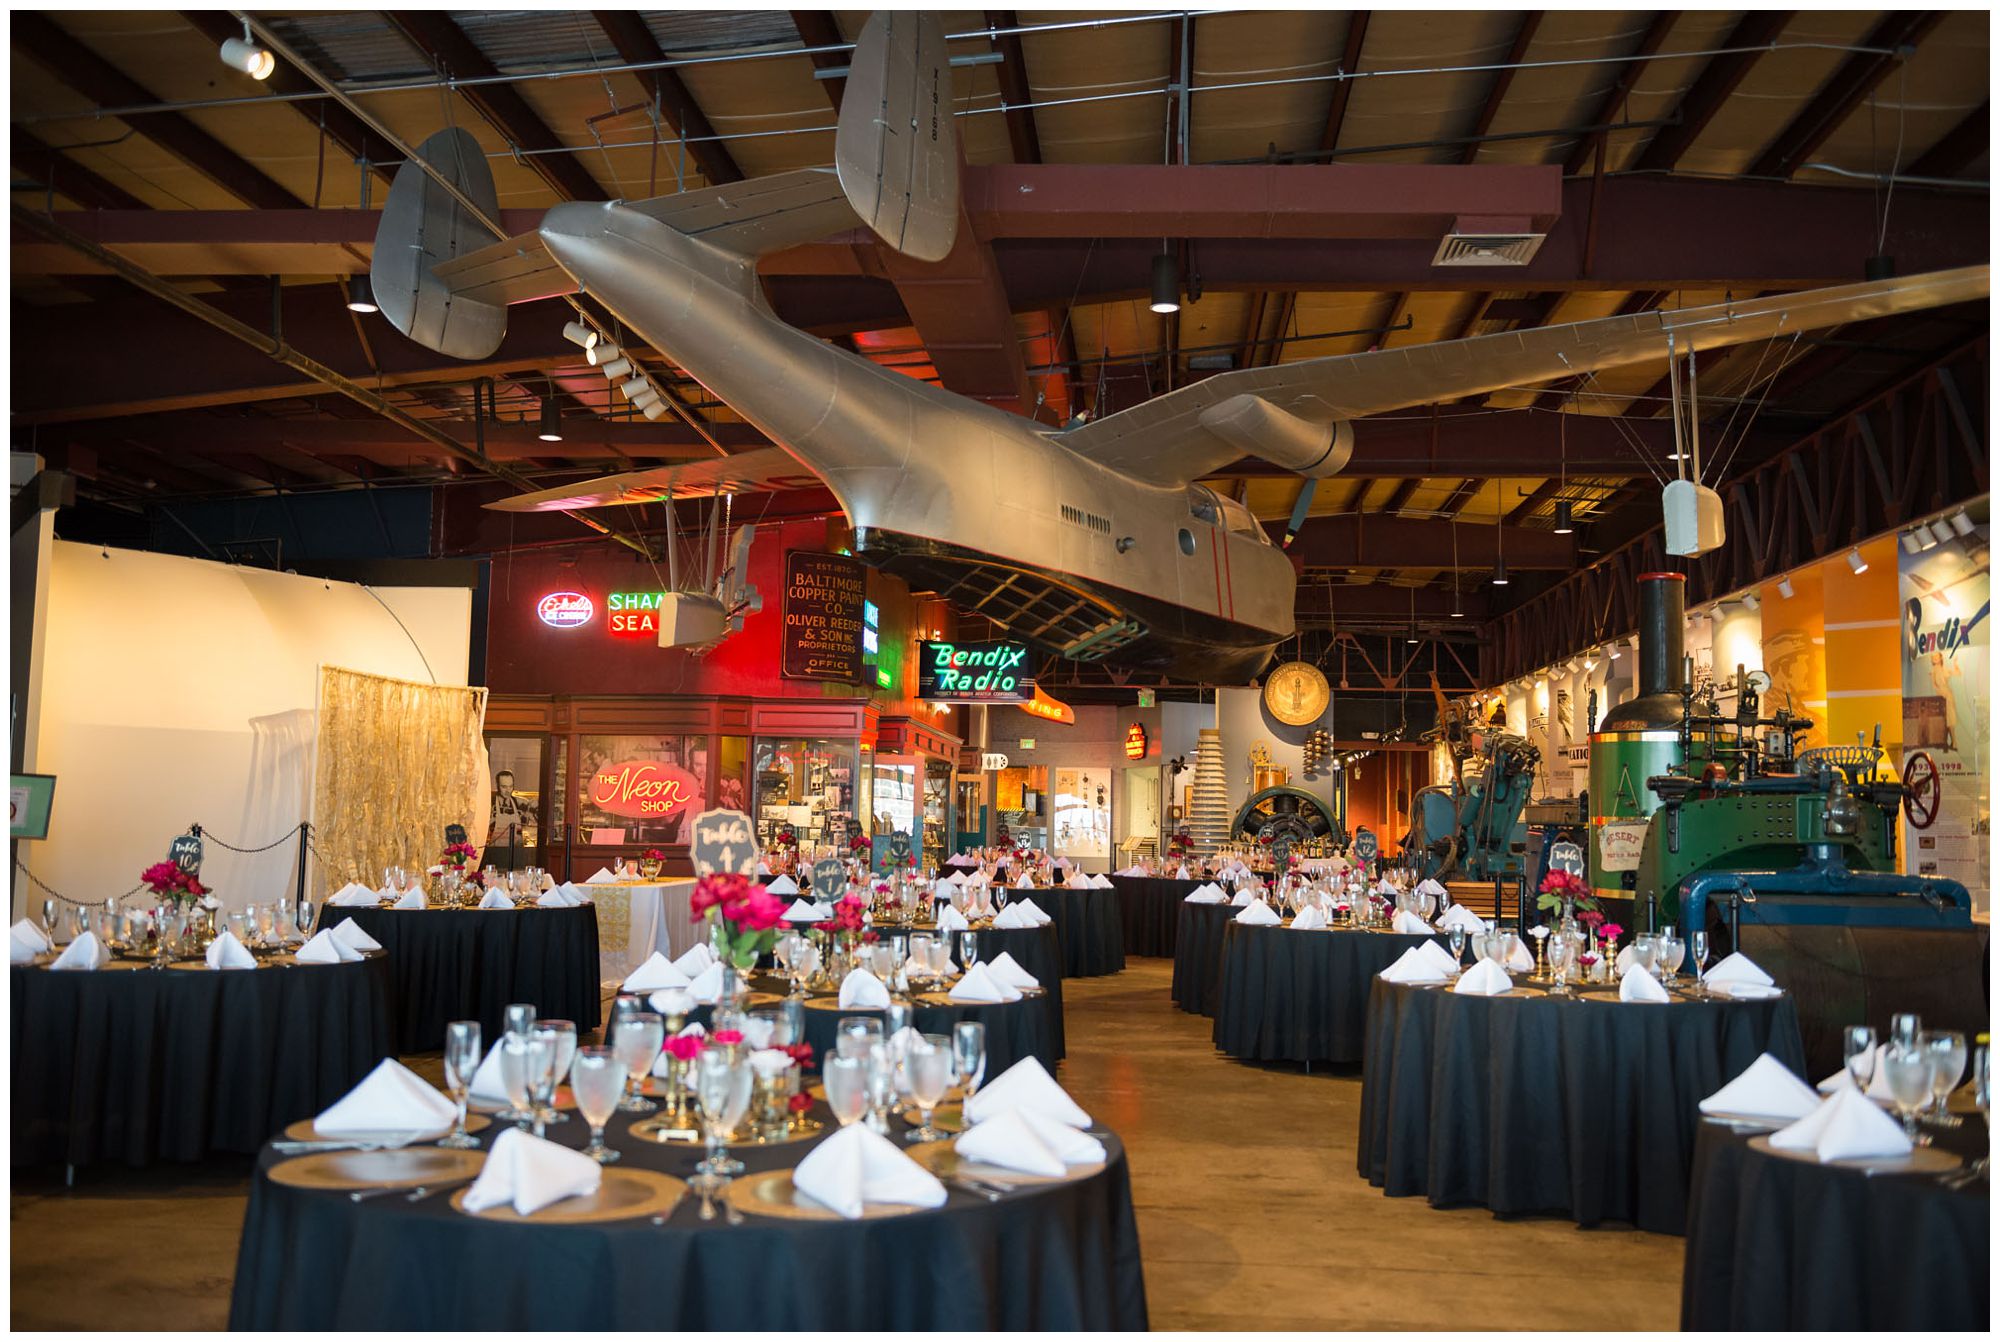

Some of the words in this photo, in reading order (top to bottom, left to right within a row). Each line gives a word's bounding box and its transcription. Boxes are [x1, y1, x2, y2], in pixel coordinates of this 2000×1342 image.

[795, 573, 863, 593] BALTIMORE
[789, 586, 836, 602] COPPER
[840, 591, 864, 606] PAINT
[825, 602, 846, 615] CO.
[612, 615, 653, 631] SEA
[786, 614, 826, 628] OLIVER
[830, 617, 861, 632] REEDER
[1905, 597, 1990, 660] Bendix
[804, 628, 816, 640] &
[820, 629, 843, 642] SON
[798, 640, 856, 653] PROPRIETORS
[808, 659, 849, 669] OFFICE
[928, 643, 1026, 671] Bendix
[933, 669, 1016, 691] Radio
[596, 766, 691, 803] Neon
[598, 774, 618, 785] THE
[641, 800, 674, 812] SHOP
[1606, 831, 1640, 846] DESERT
[180, 854, 193, 868] 10
